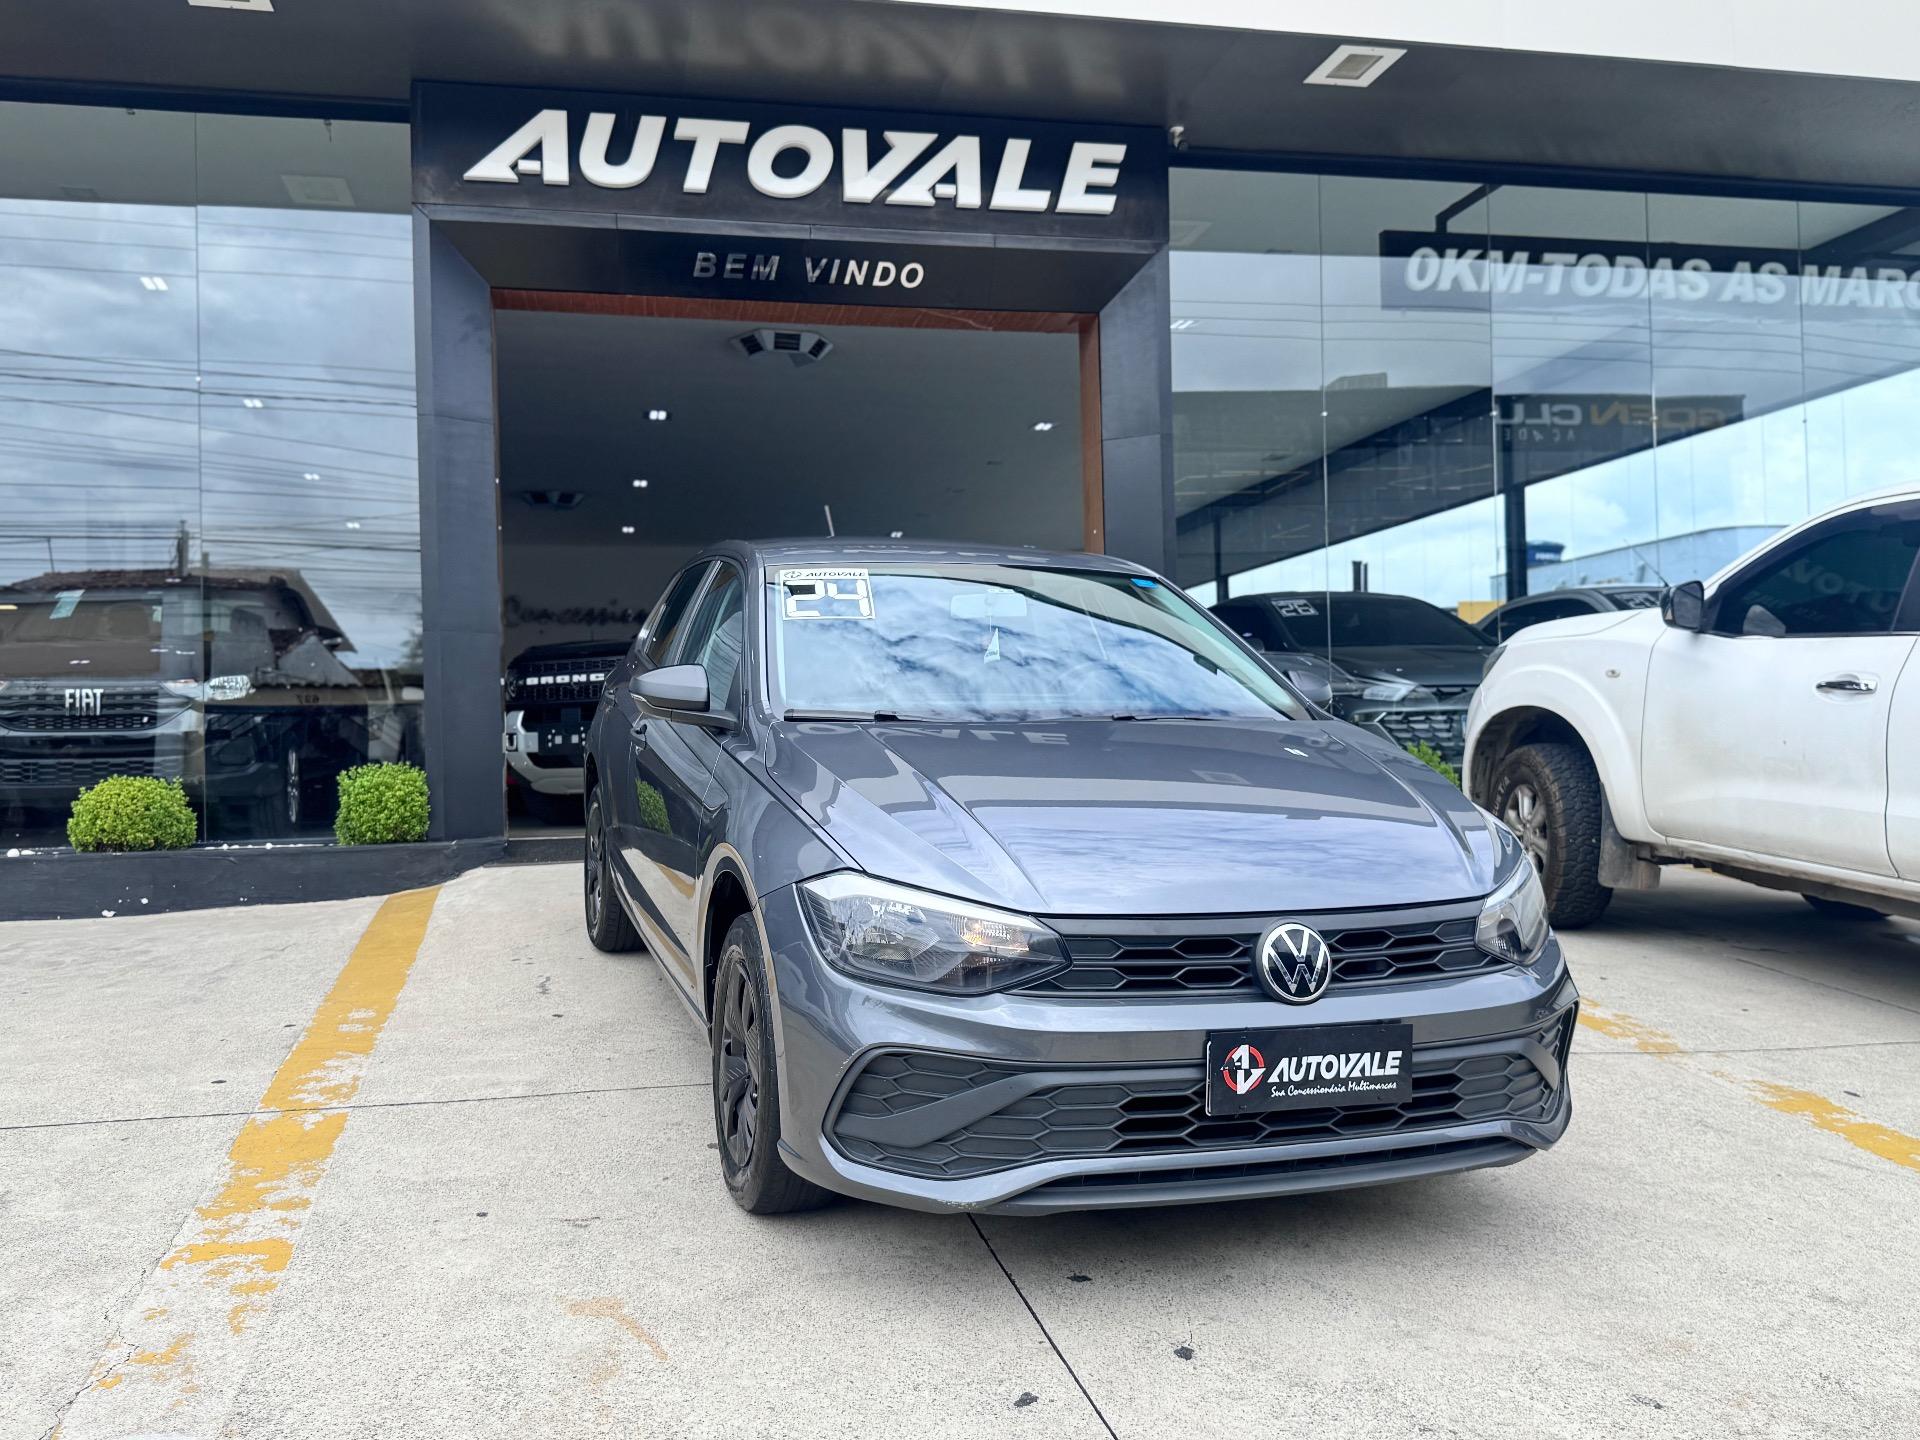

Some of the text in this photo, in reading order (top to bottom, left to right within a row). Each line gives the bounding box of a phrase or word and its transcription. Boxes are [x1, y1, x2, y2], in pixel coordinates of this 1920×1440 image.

[463, 109, 1127, 215] AUTOVALE
[693, 251, 925, 289] BEM VINDO
[1717, 261, 1790, 304] AS
[784, 579, 871, 617] 24
[1276, 601, 1316, 616] 26
[65, 688, 104, 716] FIAT
[1267, 1050, 1403, 1083] AUTOVALE
[1271, 1085, 1286, 1098] Sua
[1347, 1079, 1397, 1092] Multimarcas
